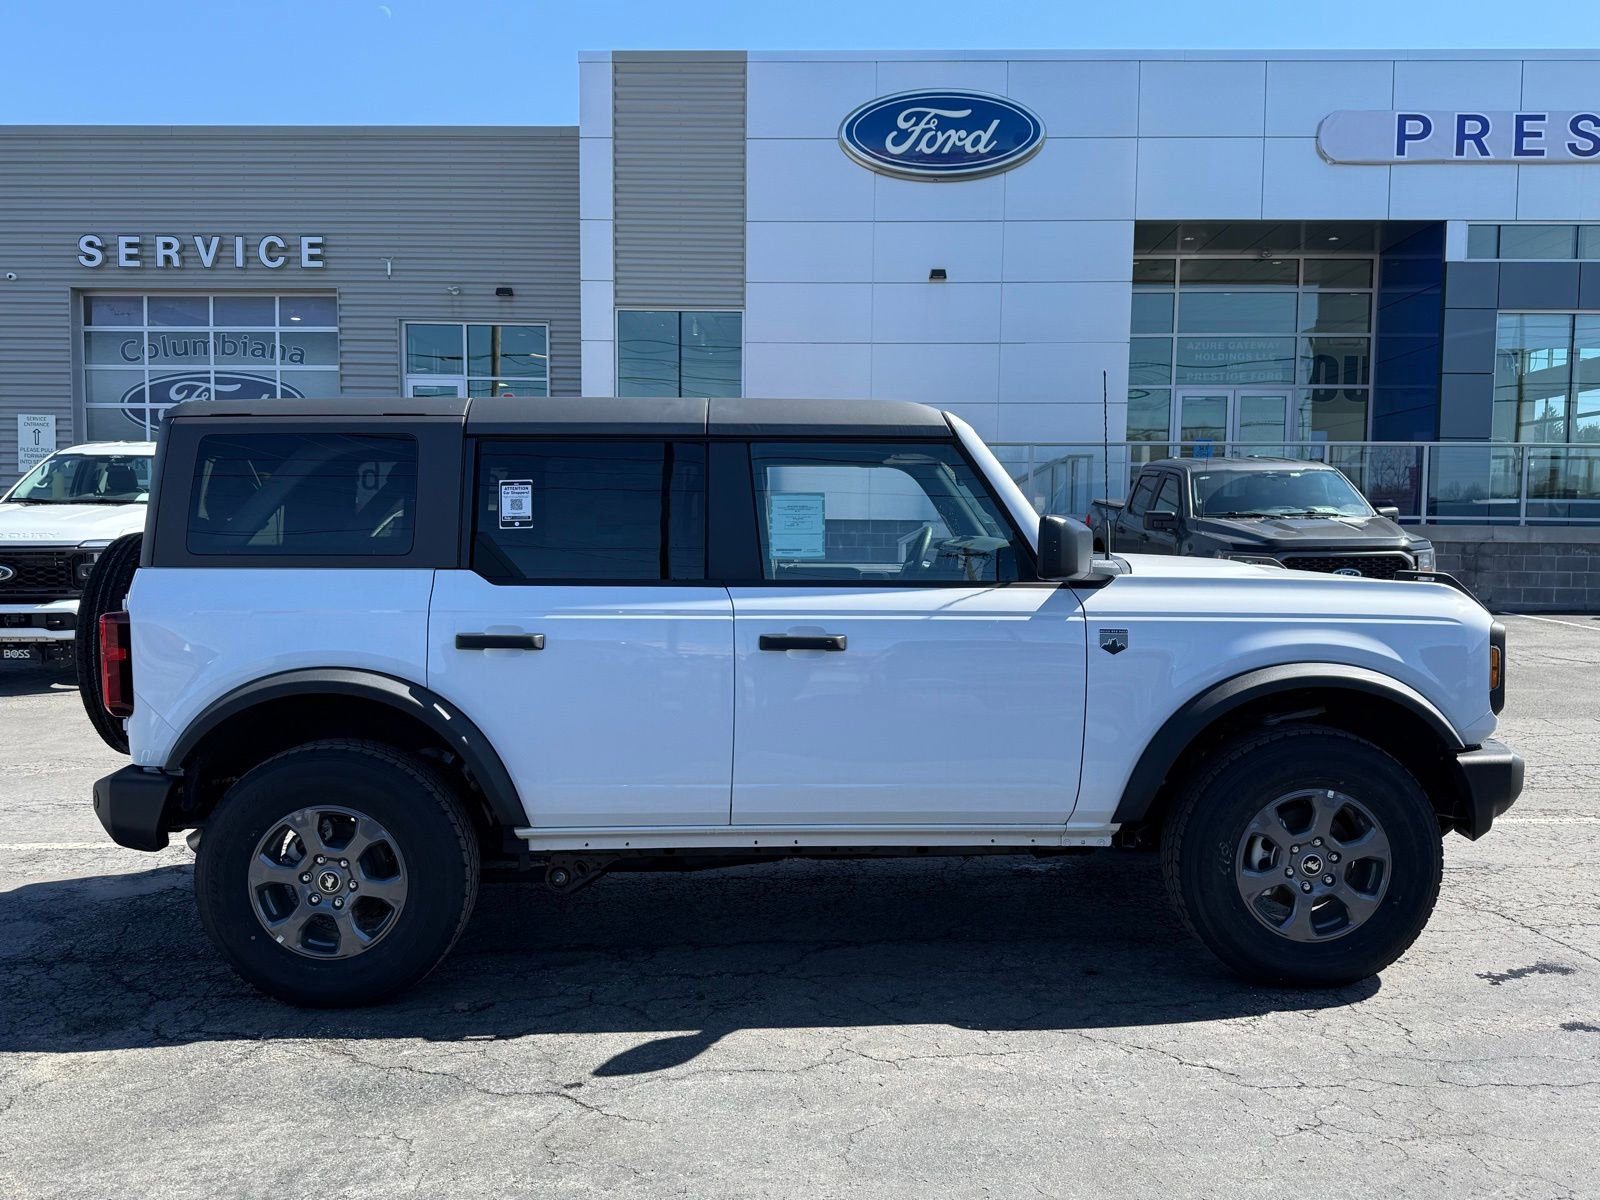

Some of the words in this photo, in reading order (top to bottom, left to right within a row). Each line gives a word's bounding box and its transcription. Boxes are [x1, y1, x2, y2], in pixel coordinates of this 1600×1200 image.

[885, 107, 1000, 154] Ford
[78, 234, 324, 268] SERVICE
[120, 334, 305, 364] Columbiana
[1186, 342, 1224, 350] AZURE
[1228, 342, 1280, 350] GATEWAY
[1195, 352, 1251, 360] HOLDINGS
[1186, 371, 1247, 380] PRESTIGE
[4, 649, 30, 659] BOSS
